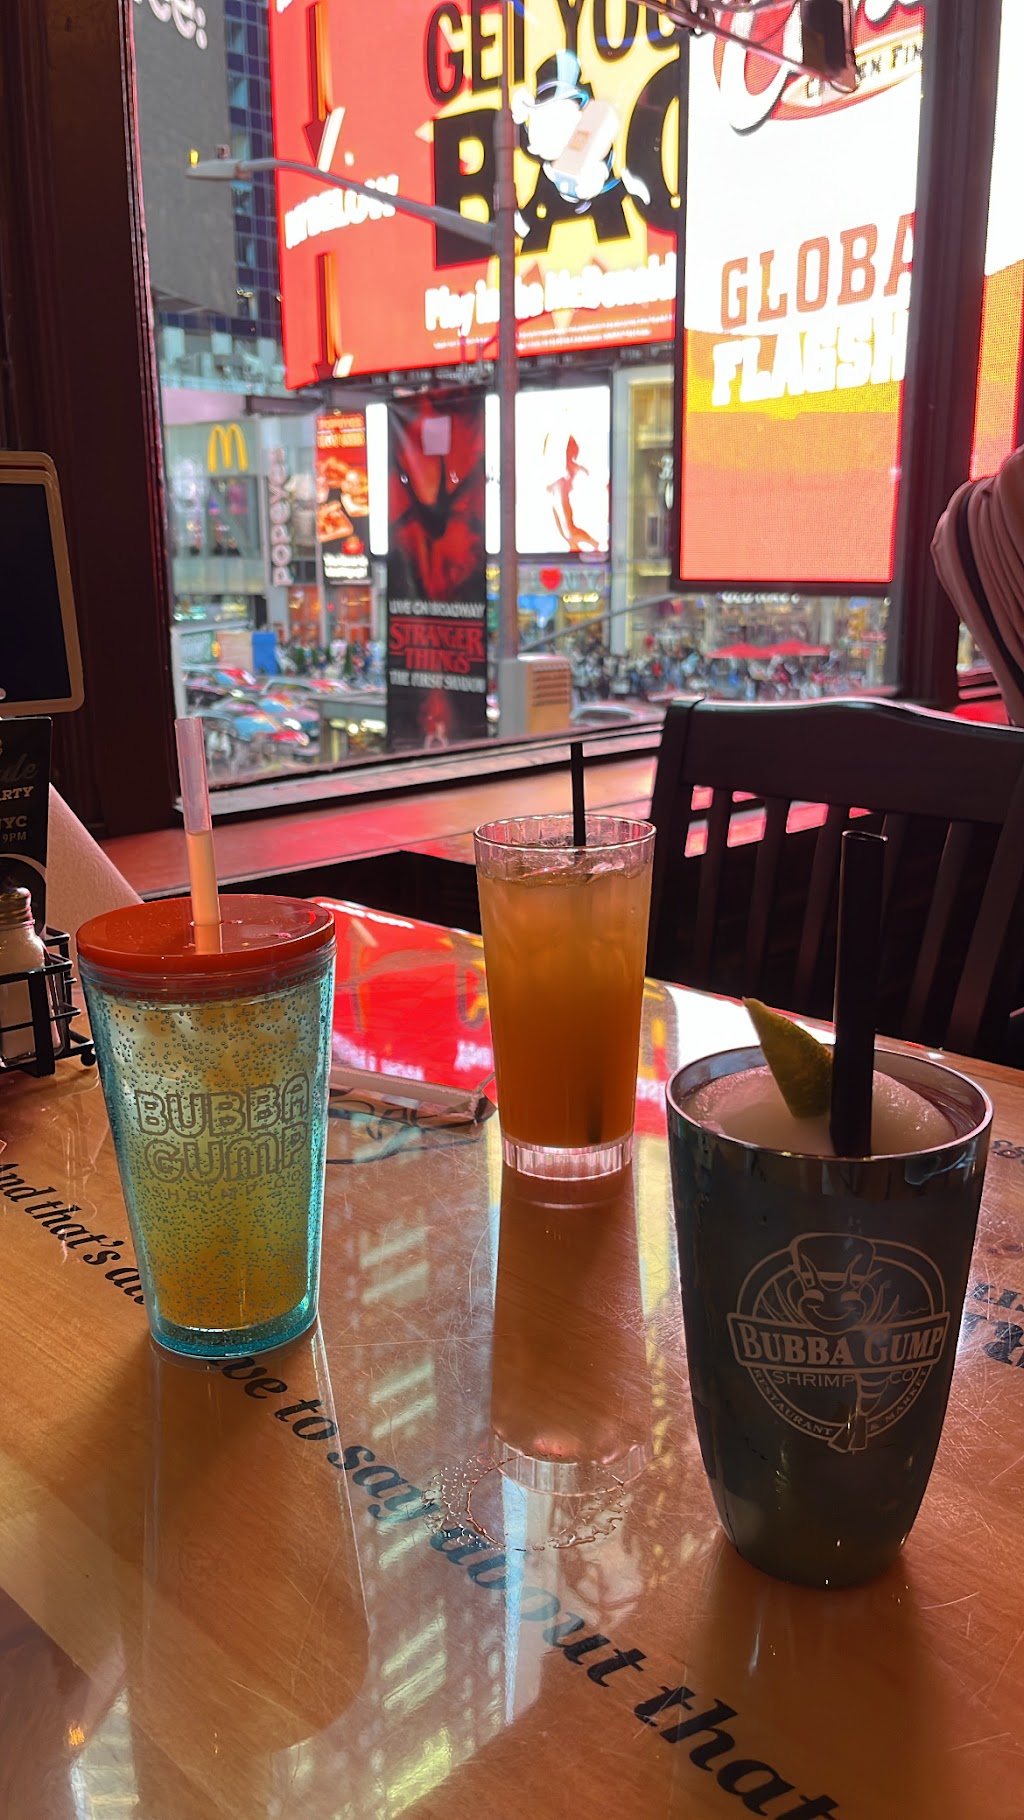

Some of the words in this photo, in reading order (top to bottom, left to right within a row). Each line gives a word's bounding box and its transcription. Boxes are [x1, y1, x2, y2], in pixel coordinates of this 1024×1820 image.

[389, 600, 412, 615] LIVE
[412, 601, 428, 616] ON
[430, 601, 486, 619] BROADWAY
[389, 622, 485, 658] STRANGER
[405, 647, 471, 674] THINGS
[389, 670, 410, 687] THE
[411, 672, 443, 689] FIRST
[444, 675, 486, 694] SHADOW
[0, 786, 34, 802] RTY
[134, 1072, 310, 1138] BUBBA
[145, 1121, 308, 1184] GUMP
[737, 1322, 855, 1366] BUBBA
[864, 1325, 944, 1365] GUMP
[772, 1371, 855, 1388] SHRIMP
[754, 1369, 833, 1437] RESTAURANT
[24, 1200, 124, 1265] that's
[274, 1399, 338, 1441] to
[326, 1445, 442, 1524] say
[430, 1526, 647, 1687] about
